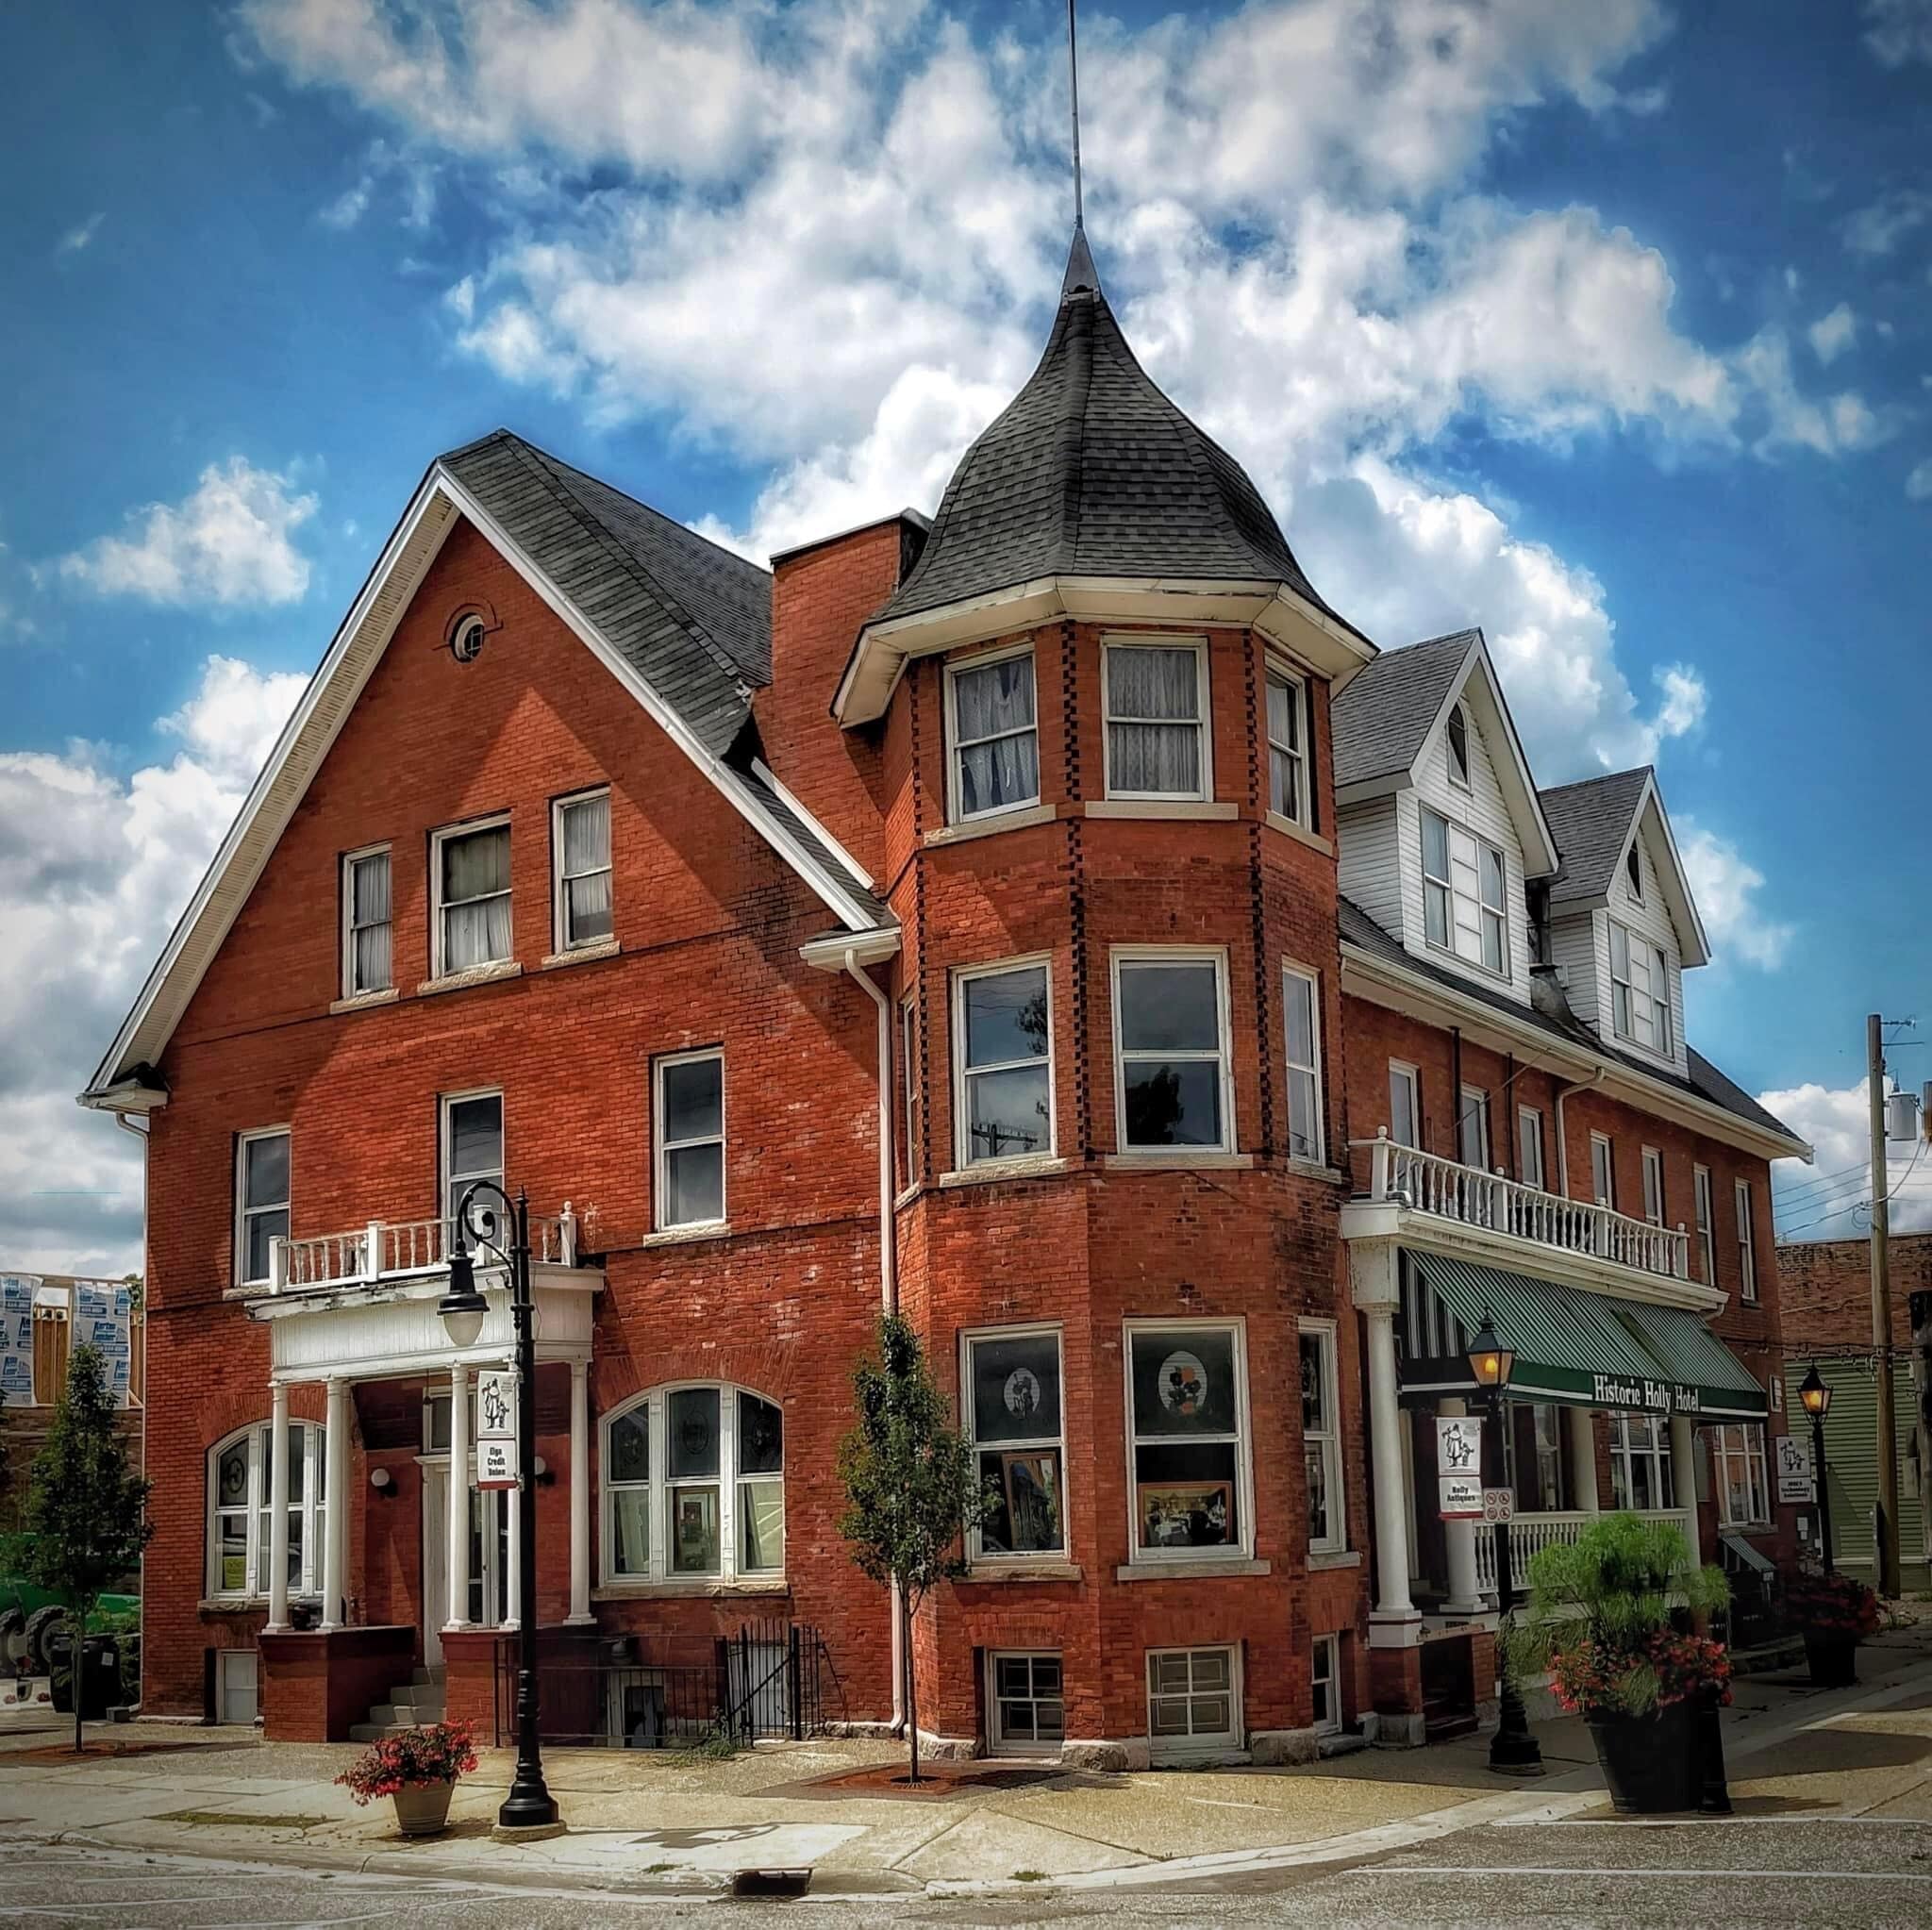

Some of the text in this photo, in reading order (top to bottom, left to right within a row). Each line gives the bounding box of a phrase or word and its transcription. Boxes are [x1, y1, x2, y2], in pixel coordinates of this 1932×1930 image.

[1592, 1374, 1700, 1414] Historic Holly Hotel
[487, 1457, 506, 1467] Credit
[488, 1468, 506, 1477] Union
[1446, 1494, 1476, 1504] Antiques
